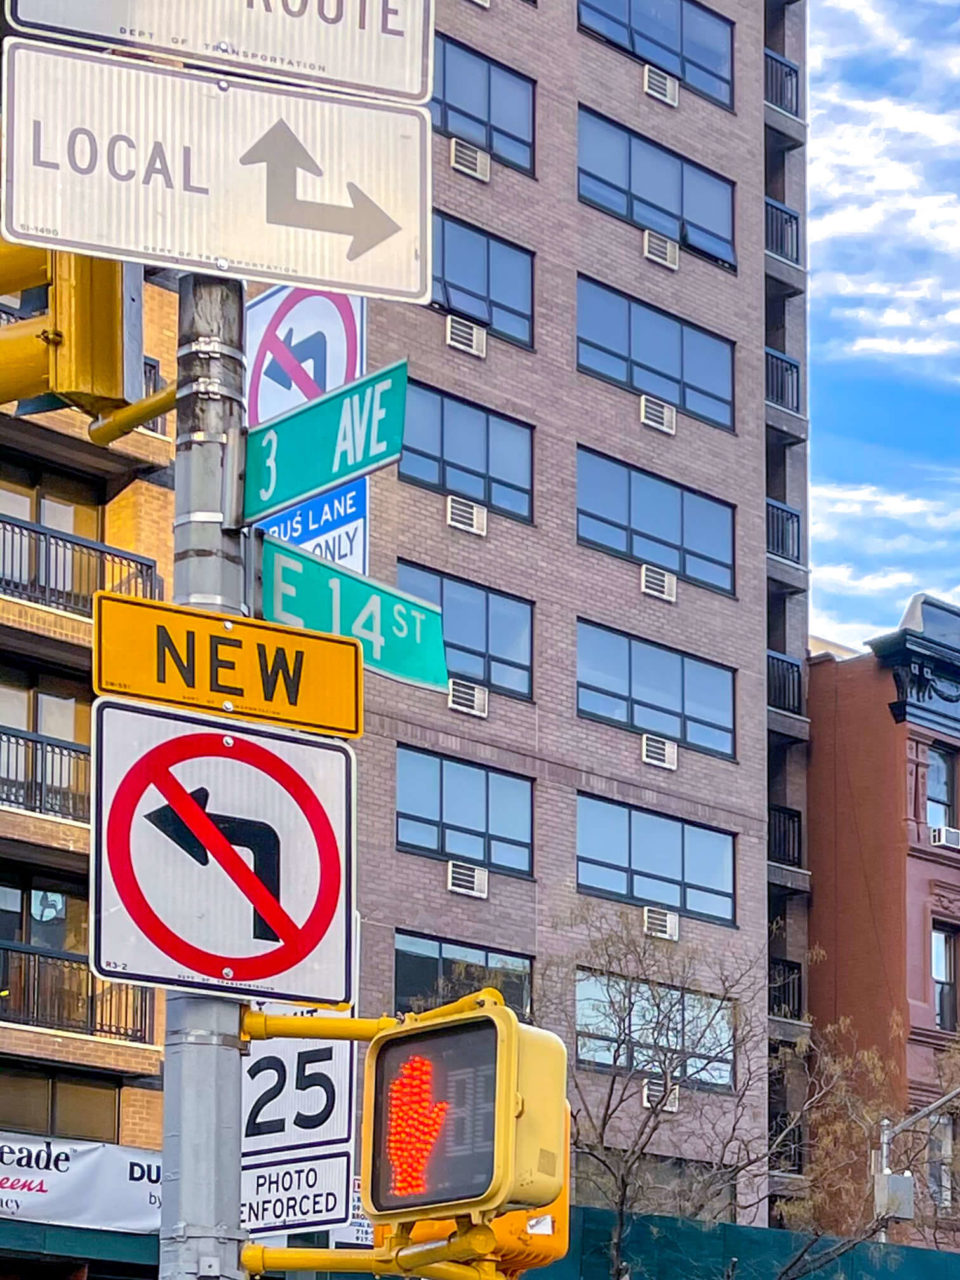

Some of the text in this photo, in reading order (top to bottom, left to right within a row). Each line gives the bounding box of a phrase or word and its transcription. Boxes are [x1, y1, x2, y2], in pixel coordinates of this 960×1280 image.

[119, 26, 155, 40] DEPT
[171, 36, 188, 46] OF
[247, 0, 405, 37] UTE
[32, 119, 210, 196] LOCAL
[259, 379, 393, 502] 3 AVE
[268, 491, 358, 542] BUS LANE
[313, 526, 359, 564] ONLY
[272, 552, 428, 661] E 14 ST
[156, 624, 306, 708] NEW
[105, 960, 129, 972] R3-2
[244, 1045, 337, 1139] 25
[129, 1161, 162, 1185] DU
[256, 1167, 318, 1196] PHOTO
[240, 1191, 338, 1224] ENFORCED
